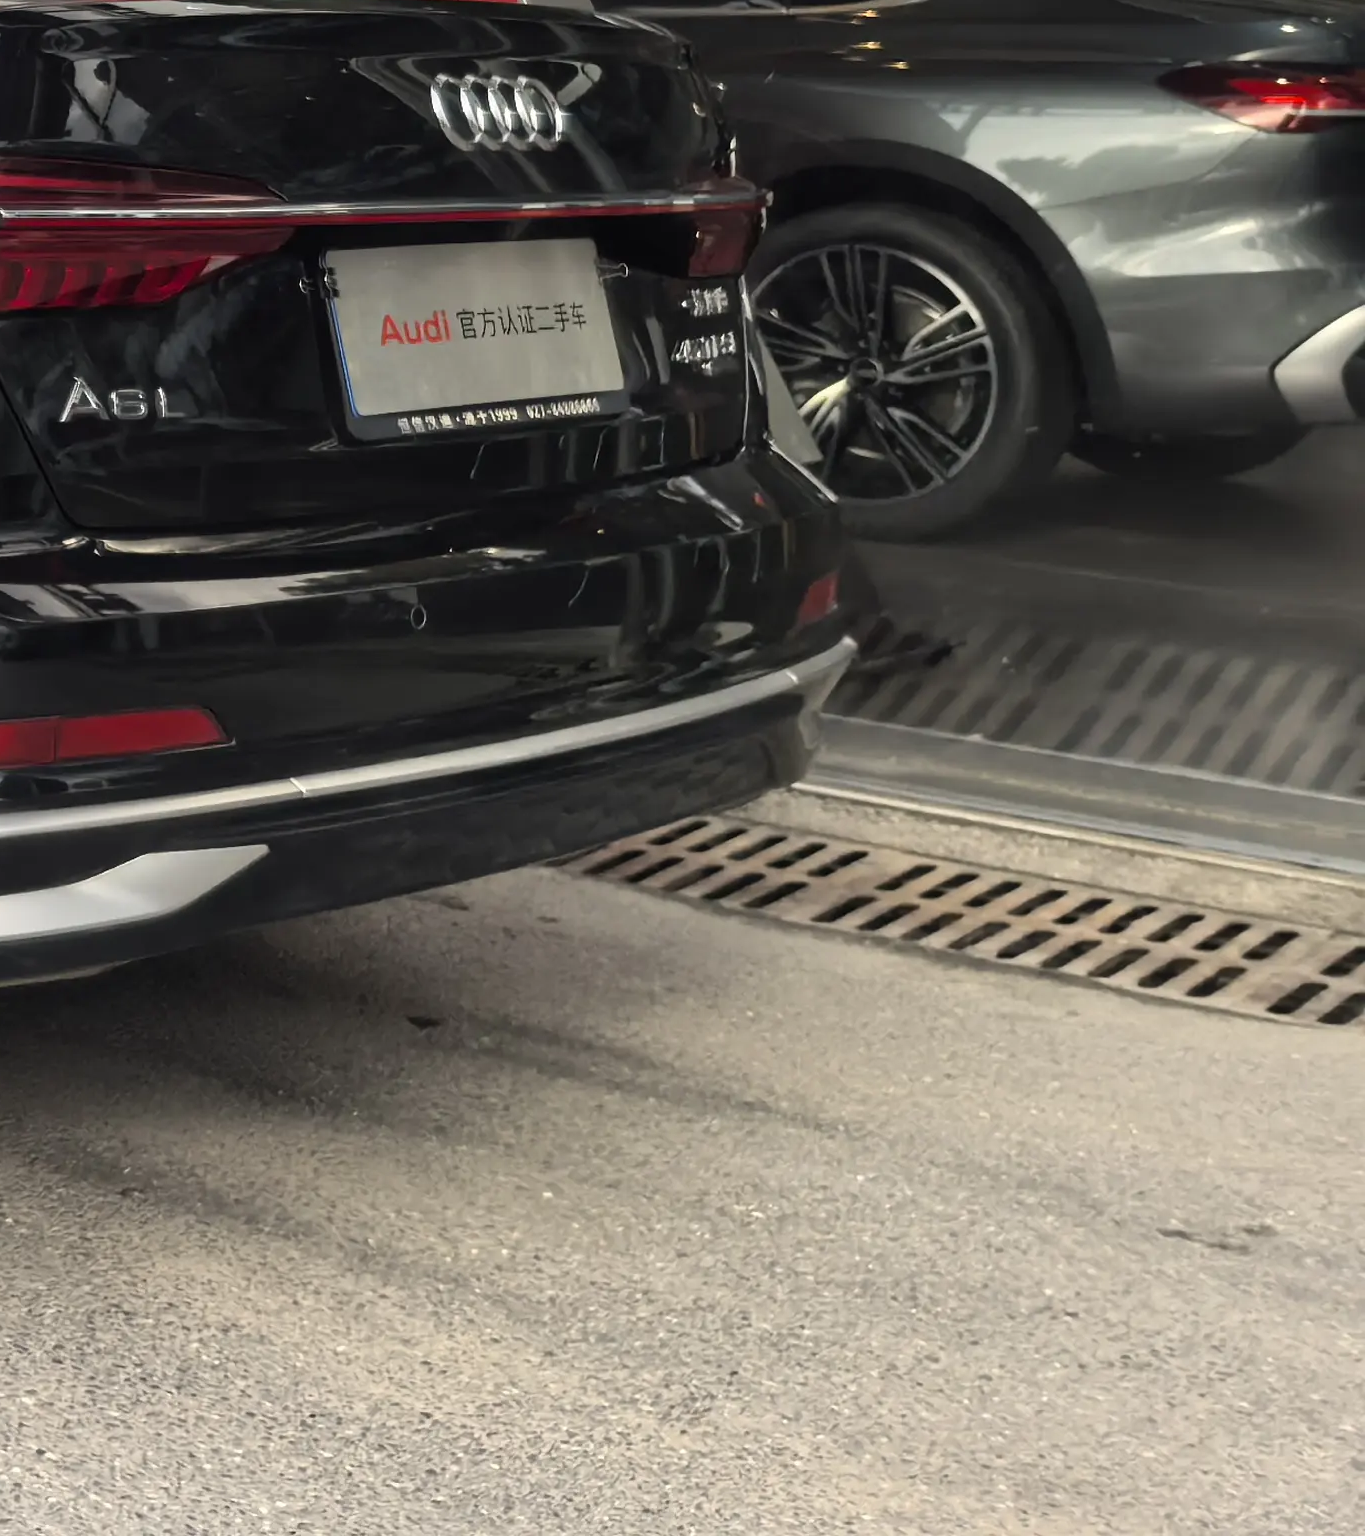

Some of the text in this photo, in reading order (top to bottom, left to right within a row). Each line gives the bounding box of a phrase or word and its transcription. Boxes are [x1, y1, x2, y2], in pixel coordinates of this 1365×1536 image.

[380, 302, 587, 346] Audi 官方认证二手车
[58, 375, 186, 423] A6L
